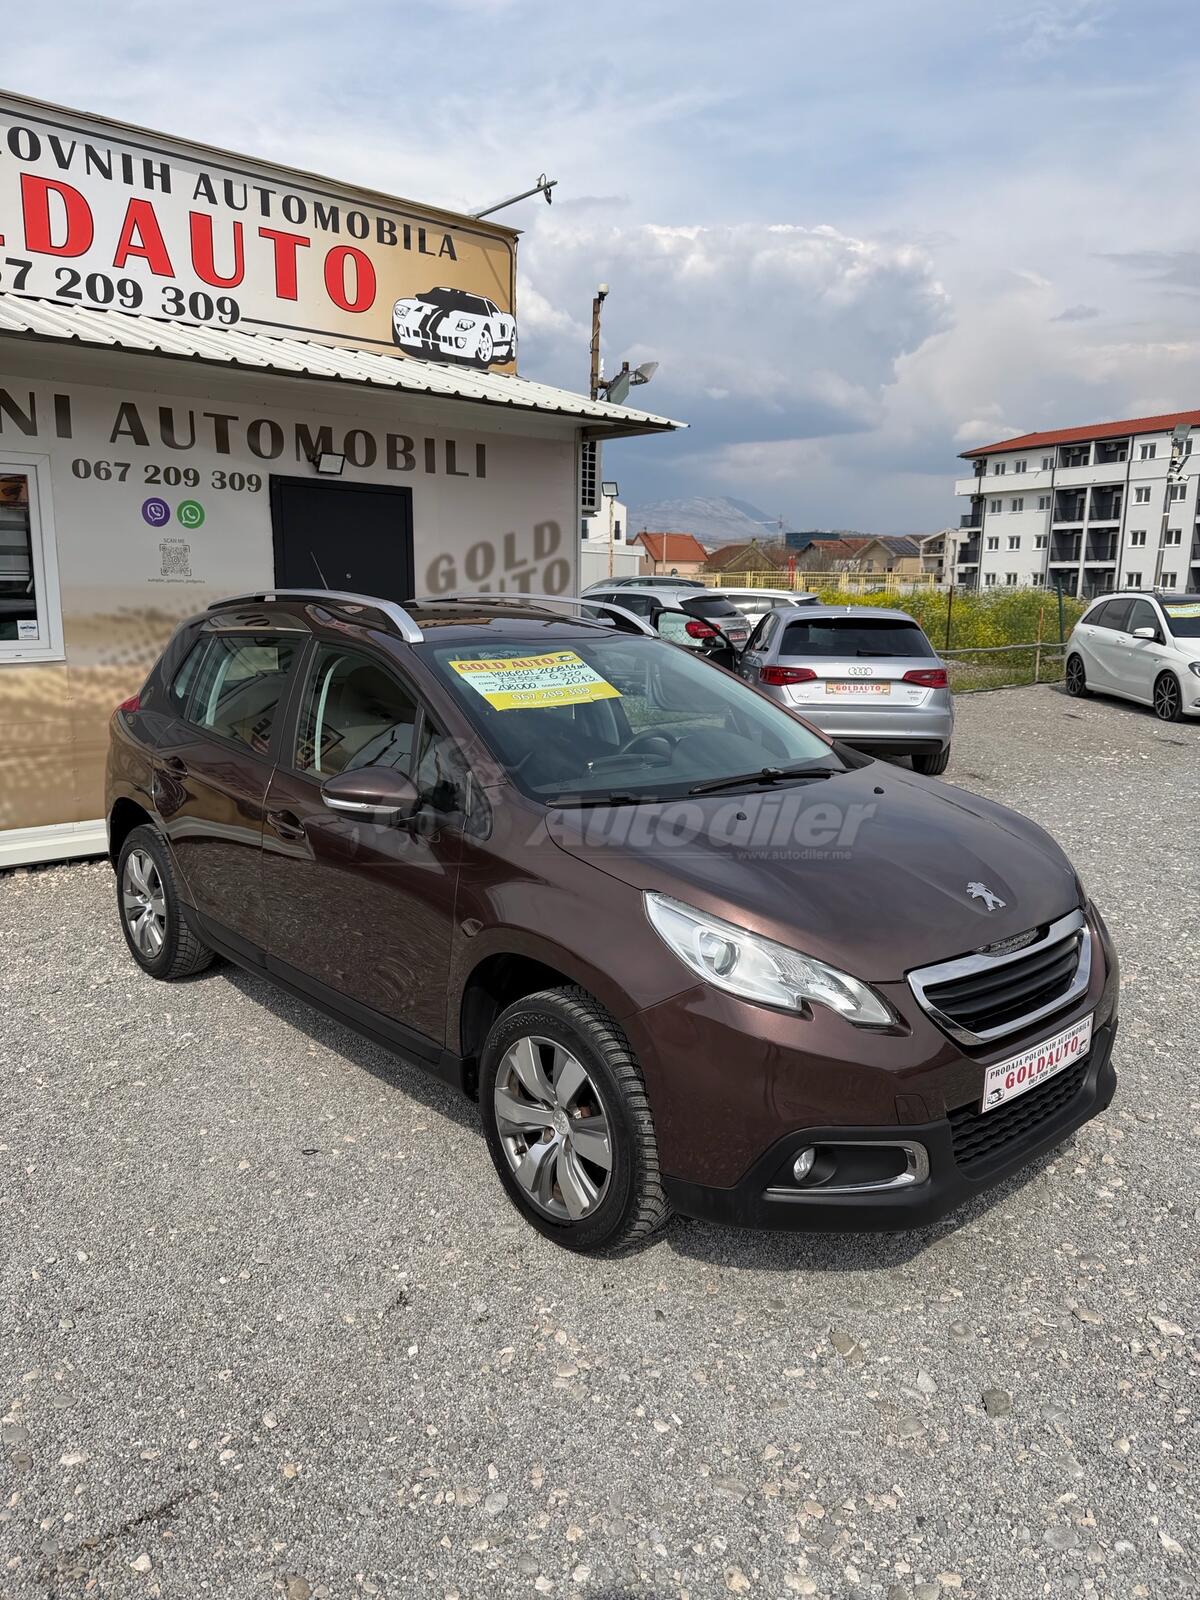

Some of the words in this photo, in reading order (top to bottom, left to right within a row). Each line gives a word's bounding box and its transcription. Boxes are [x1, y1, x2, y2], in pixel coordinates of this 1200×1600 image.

[0, 126, 171, 194] OVNIH
[192, 172, 458, 261] AUTOMOBILA
[0, 172, 377, 313] DAUTO
[0, 257, 33, 291] 7
[55, 267, 143, 309] 209
[161, 285, 241, 325] 309
[109, 401, 486, 478] AUTOMOBILI
[71, 458, 131, 482] 067
[143, 464, 200, 488] 209
[211, 470, 262, 493] 309
[425, 520, 562, 595] GOLD
[457, 661, 506, 672] GOLD
[511, 657, 553, 669] AUTO
[989, 1059, 1023, 1080] PRODAJA
[1024, 1041, 1056, 1063] POLOVNIH
[1005, 1035, 1079, 1089] GOLDAUTO
